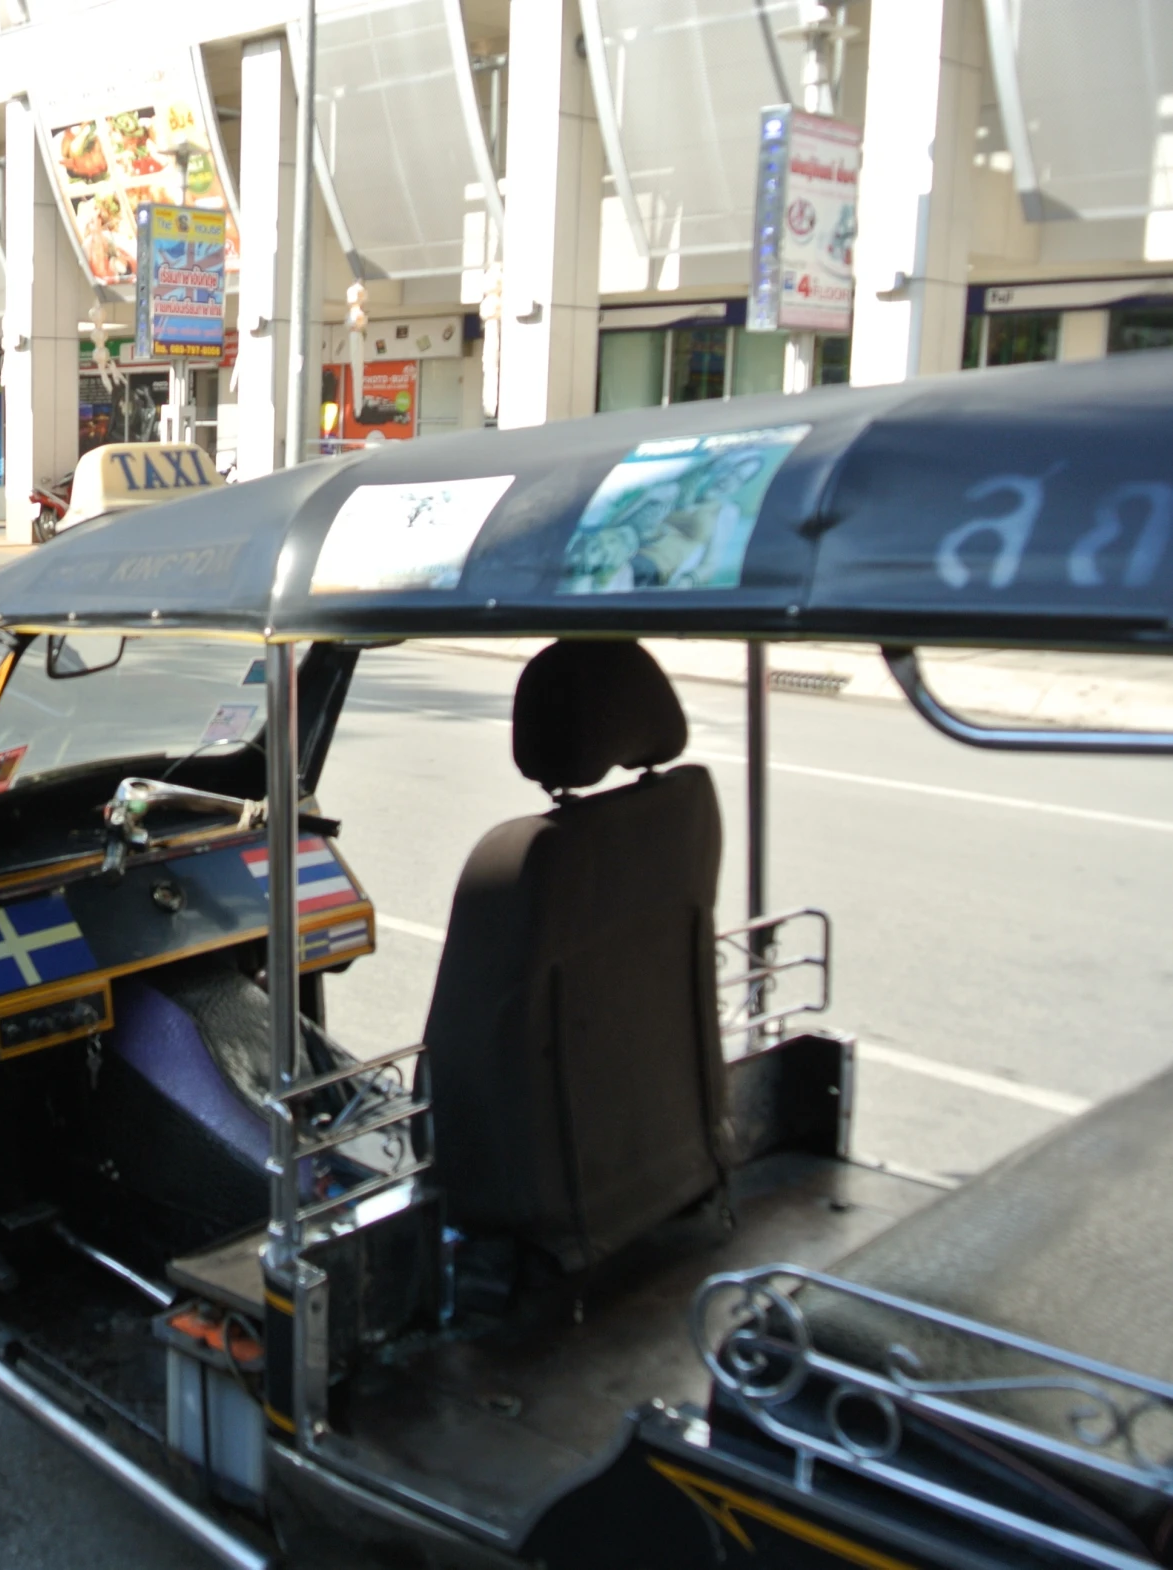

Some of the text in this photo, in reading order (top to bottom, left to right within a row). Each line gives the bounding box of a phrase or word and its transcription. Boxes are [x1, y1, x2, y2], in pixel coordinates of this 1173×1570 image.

[797, 273, 849, 301] 4 FLOOR
[111, 450, 212, 491] TAXI
